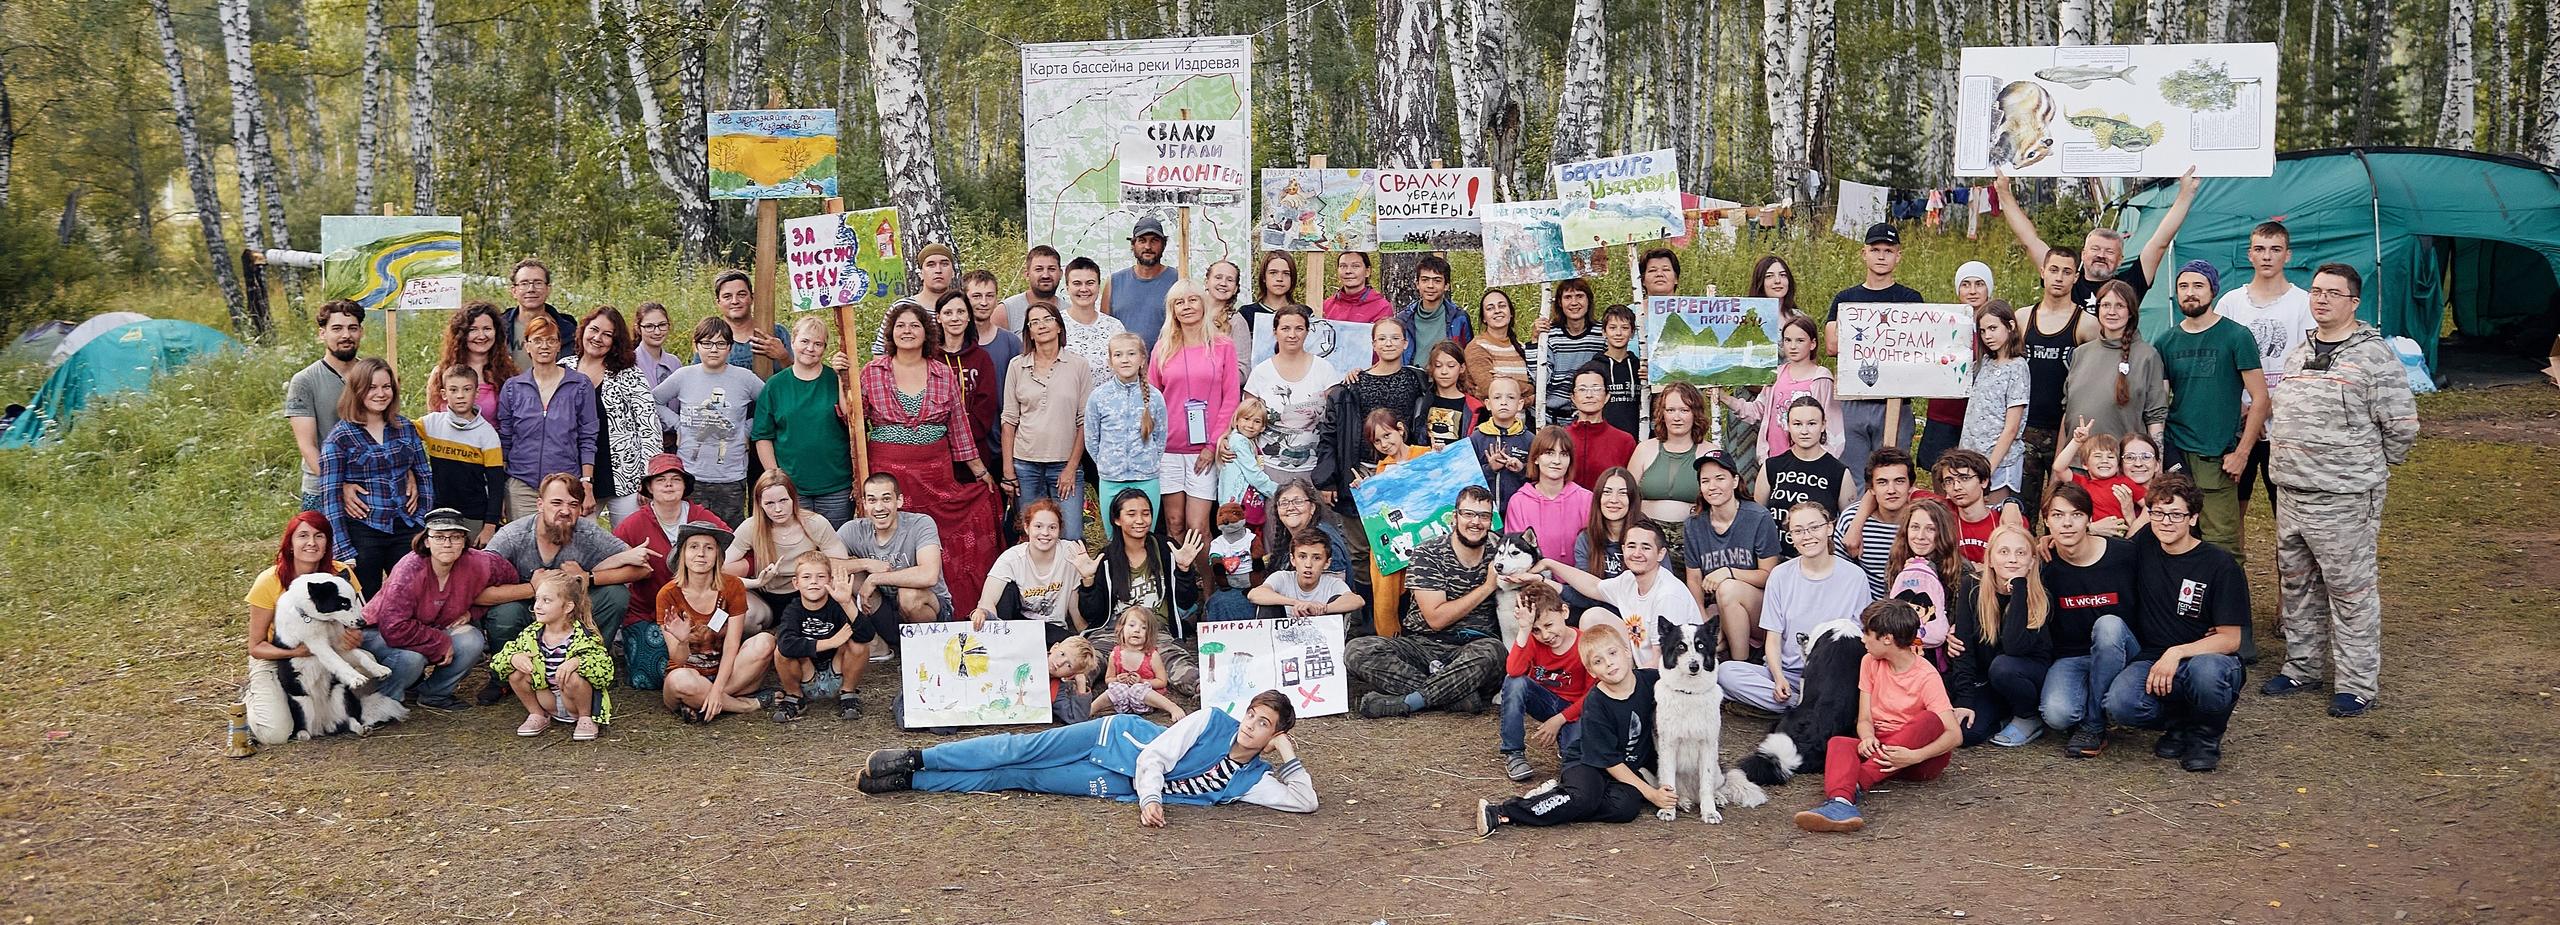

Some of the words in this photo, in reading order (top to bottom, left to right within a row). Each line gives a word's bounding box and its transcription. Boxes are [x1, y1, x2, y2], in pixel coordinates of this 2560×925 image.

[1029, 62, 1068, 77] Карта
[1072, 60, 1133, 75] бассейна
[1138, 61, 1170, 77] реки
[1174, 57, 1240, 72] Издревая
[1147, 122, 1216, 142] СВАЛКУ
[1156, 143, 1223, 158] УБРАЛИ
[1379, 173, 1461, 192] СВАЛКУ
[1406, 190, 1456, 202] УБРАЛИ
[792, 226, 816, 246] ЗА
[793, 266, 838, 290] РЕКУ
[1654, 298, 1741, 314] БЕРЕГИТЕ
[1846, 306, 1878, 322] ЭТУ
[1891, 309, 1944, 324] СВАЛКУ
[1872, 326, 1935, 348] УБРАЛИ
[431, 444, 481, 458] ADVENTURE
[1773, 471, 1829, 490] peace
[1770, 507, 1789, 521] an
[2064, 597, 2075, 607] It
[2076, 595, 2111, 606] works.
[1202, 621, 1263, 634] ПРИРОДА
